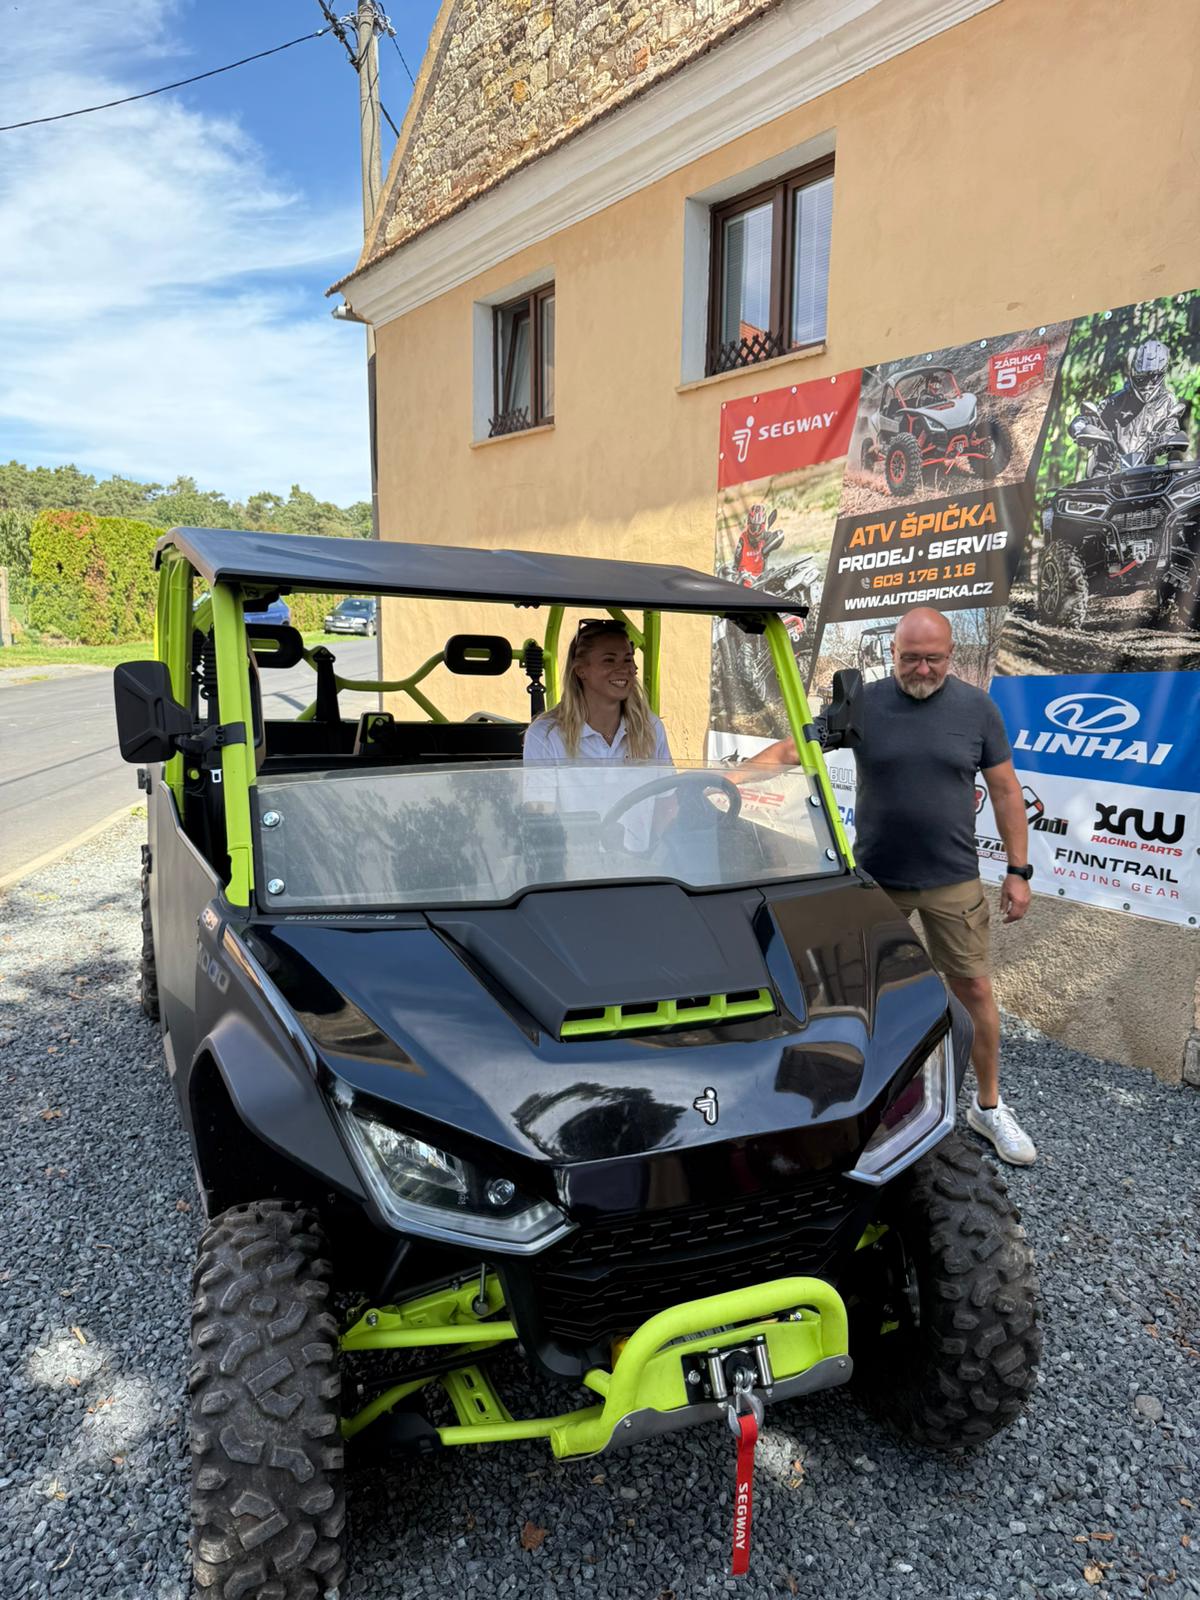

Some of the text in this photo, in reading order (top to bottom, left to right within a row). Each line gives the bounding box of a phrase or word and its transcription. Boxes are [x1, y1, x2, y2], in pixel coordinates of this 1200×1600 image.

[994, 353, 1042, 369] ZÁRUKA
[996, 362, 1036, 389] 5 LET
[758, 411, 835, 440] SEGWAY
[849, 501, 997, 549] ATV ŠPIČKA
[837, 531, 1008, 574] PRODEJ SERVIS
[872, 562, 976, 589] 603 176 116
[844, 581, 994, 611] WWW.AUTOSPICKA.CZ
[1013, 729, 1174, 766] LINHAI
[1091, 835, 1183, 857] RACING PARTS
[1054, 847, 1179, 884] FINNTRAIL
[1053, 866, 1179, 899] WADING GEAR
[735, 1482, 749, 1550] SEGWAY
